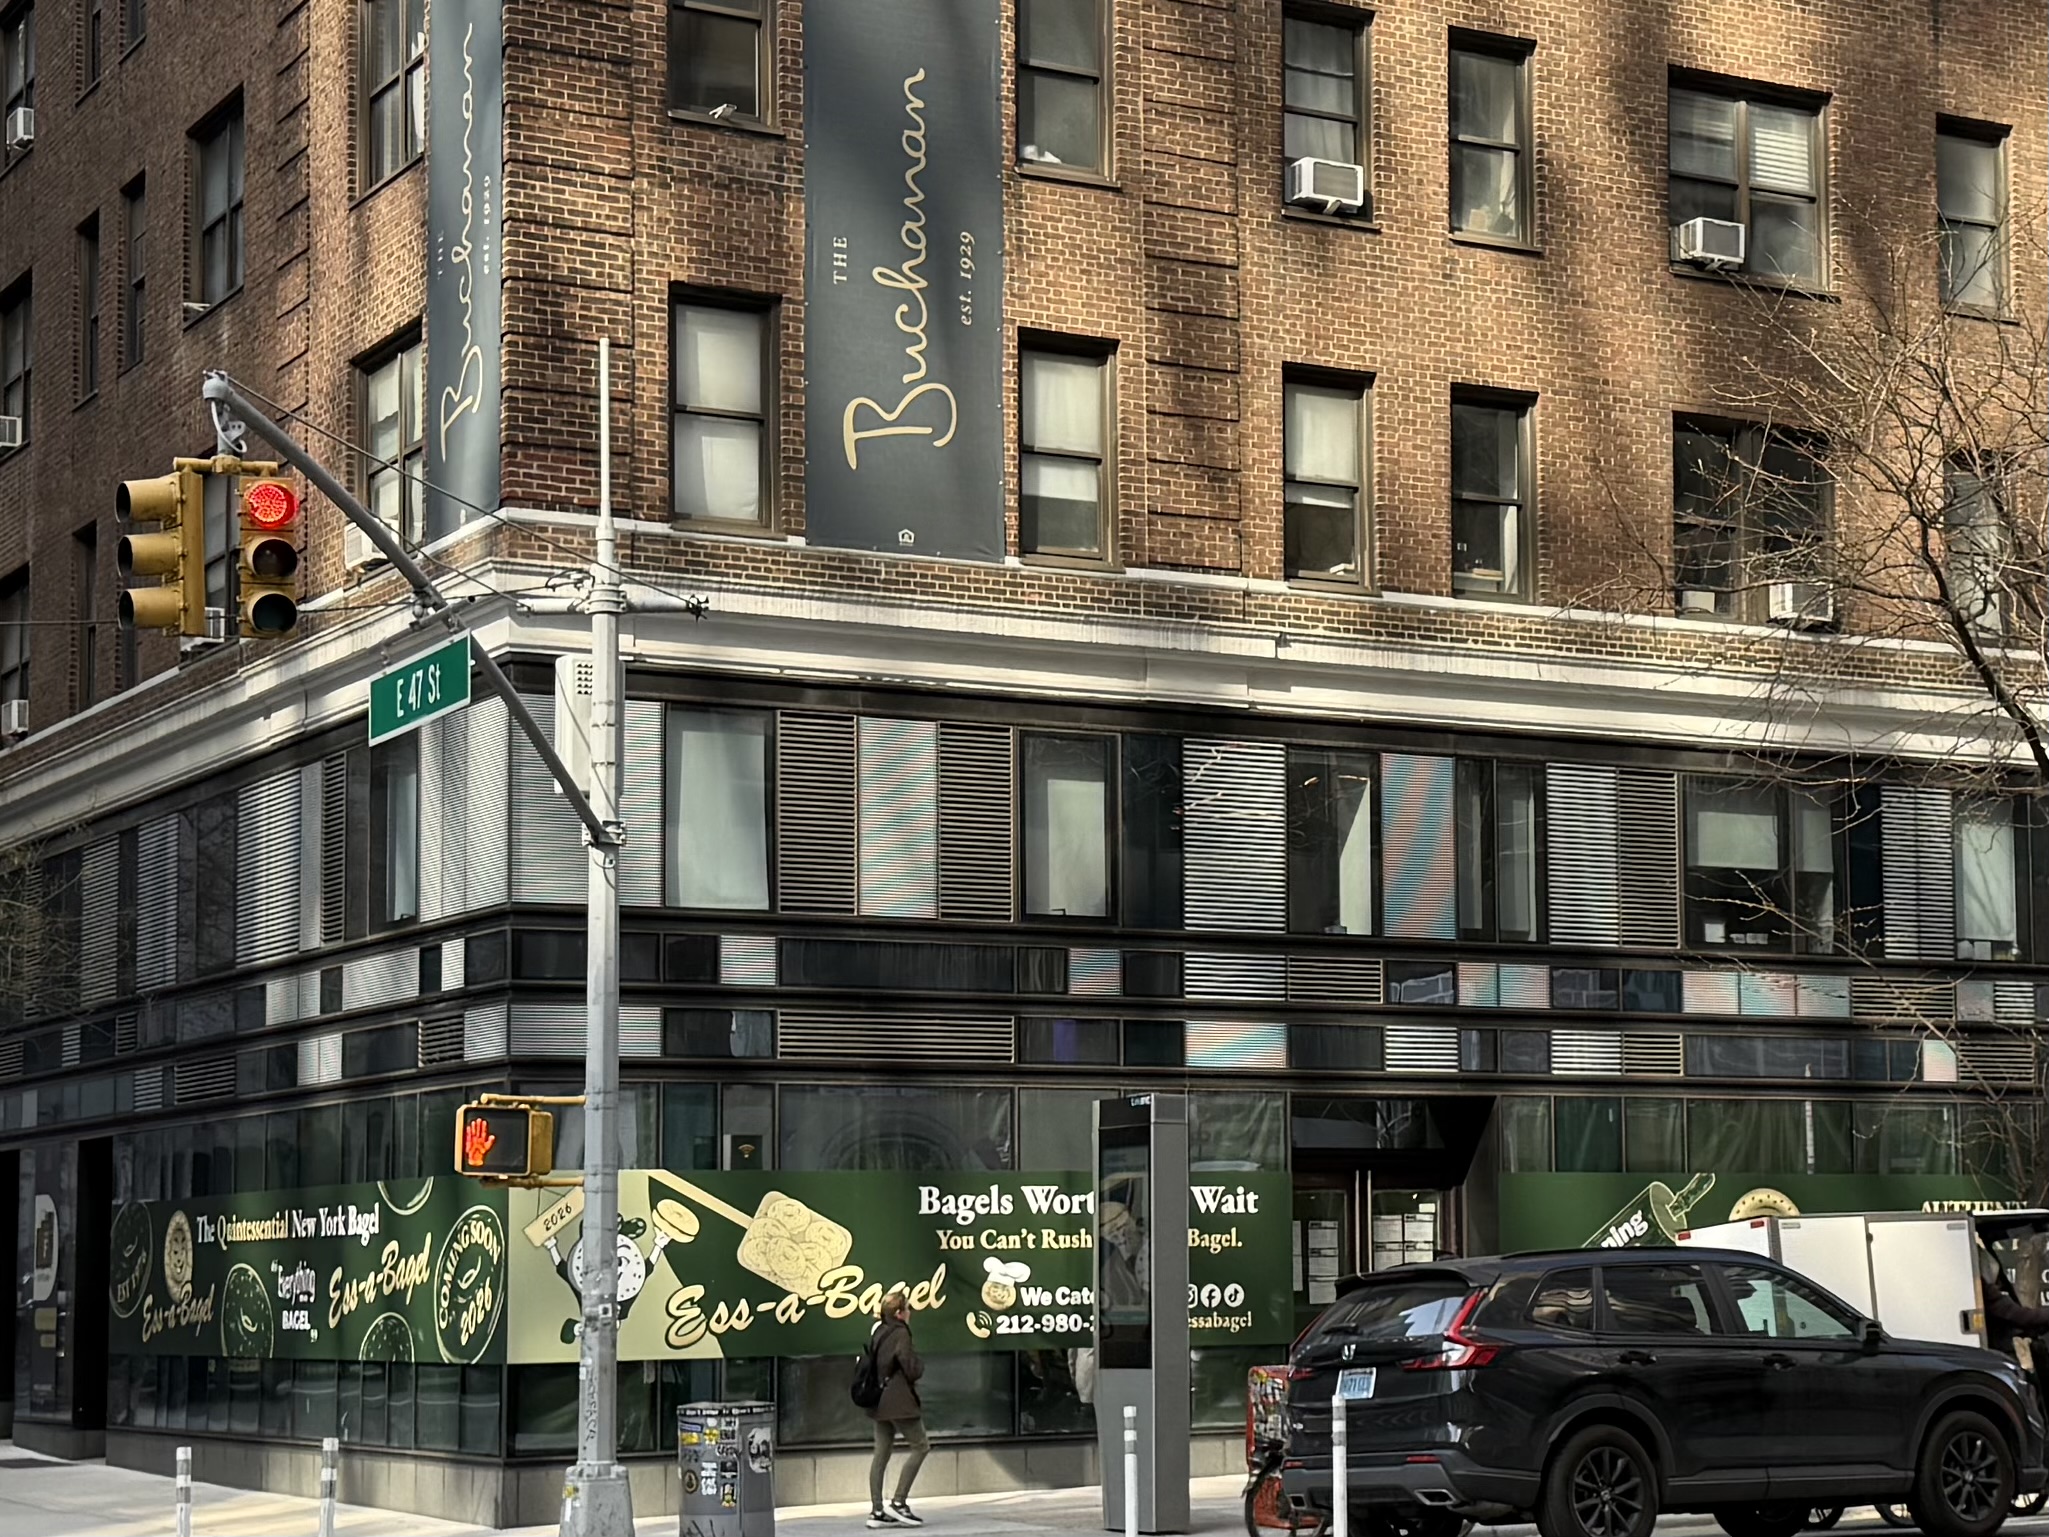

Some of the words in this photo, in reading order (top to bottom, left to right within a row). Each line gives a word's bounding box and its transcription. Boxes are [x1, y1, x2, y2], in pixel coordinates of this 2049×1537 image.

[440, 22, 483, 463] Buchanan
[833, 235, 848, 284] THE
[959, 231, 976, 280] 1929
[843, 67, 957, 470] Buchanan
[959, 290, 973, 326] est.
[396, 678, 404, 718] E
[408, 669, 423, 711] 47
[428, 663, 441, 704] St
[196, 1215, 215, 1243] The
[217, 1209, 289, 1250] Quintessential
[292, 1209, 316, 1238] New
[318, 1204, 346, 1237] York
[347, 1202, 380, 1247] Bagel
[543, 1202, 572, 1232] 2026
[918, 1184, 1014, 1226] Bagels
[1020, 1185, 1095, 1215] Wort
[1190, 1185, 1259, 1214] Wait
[936, 1229, 975, 1250] You
[980, 1228, 1037, 1250] Can’t
[1041, 1228, 1094, 1249] Rush
[1187, 1226, 1243, 1255] Bagel.
[328, 1233, 432, 1329] Ess-a-Bagel
[439, 1224, 470, 1330] COMING
[470, 1220, 501, 1265] SOON
[1020, 1286, 1053, 1306] We
[142, 1282, 215, 1343] Ess-a-Bagel
[460, 1276, 493, 1346] 2026
